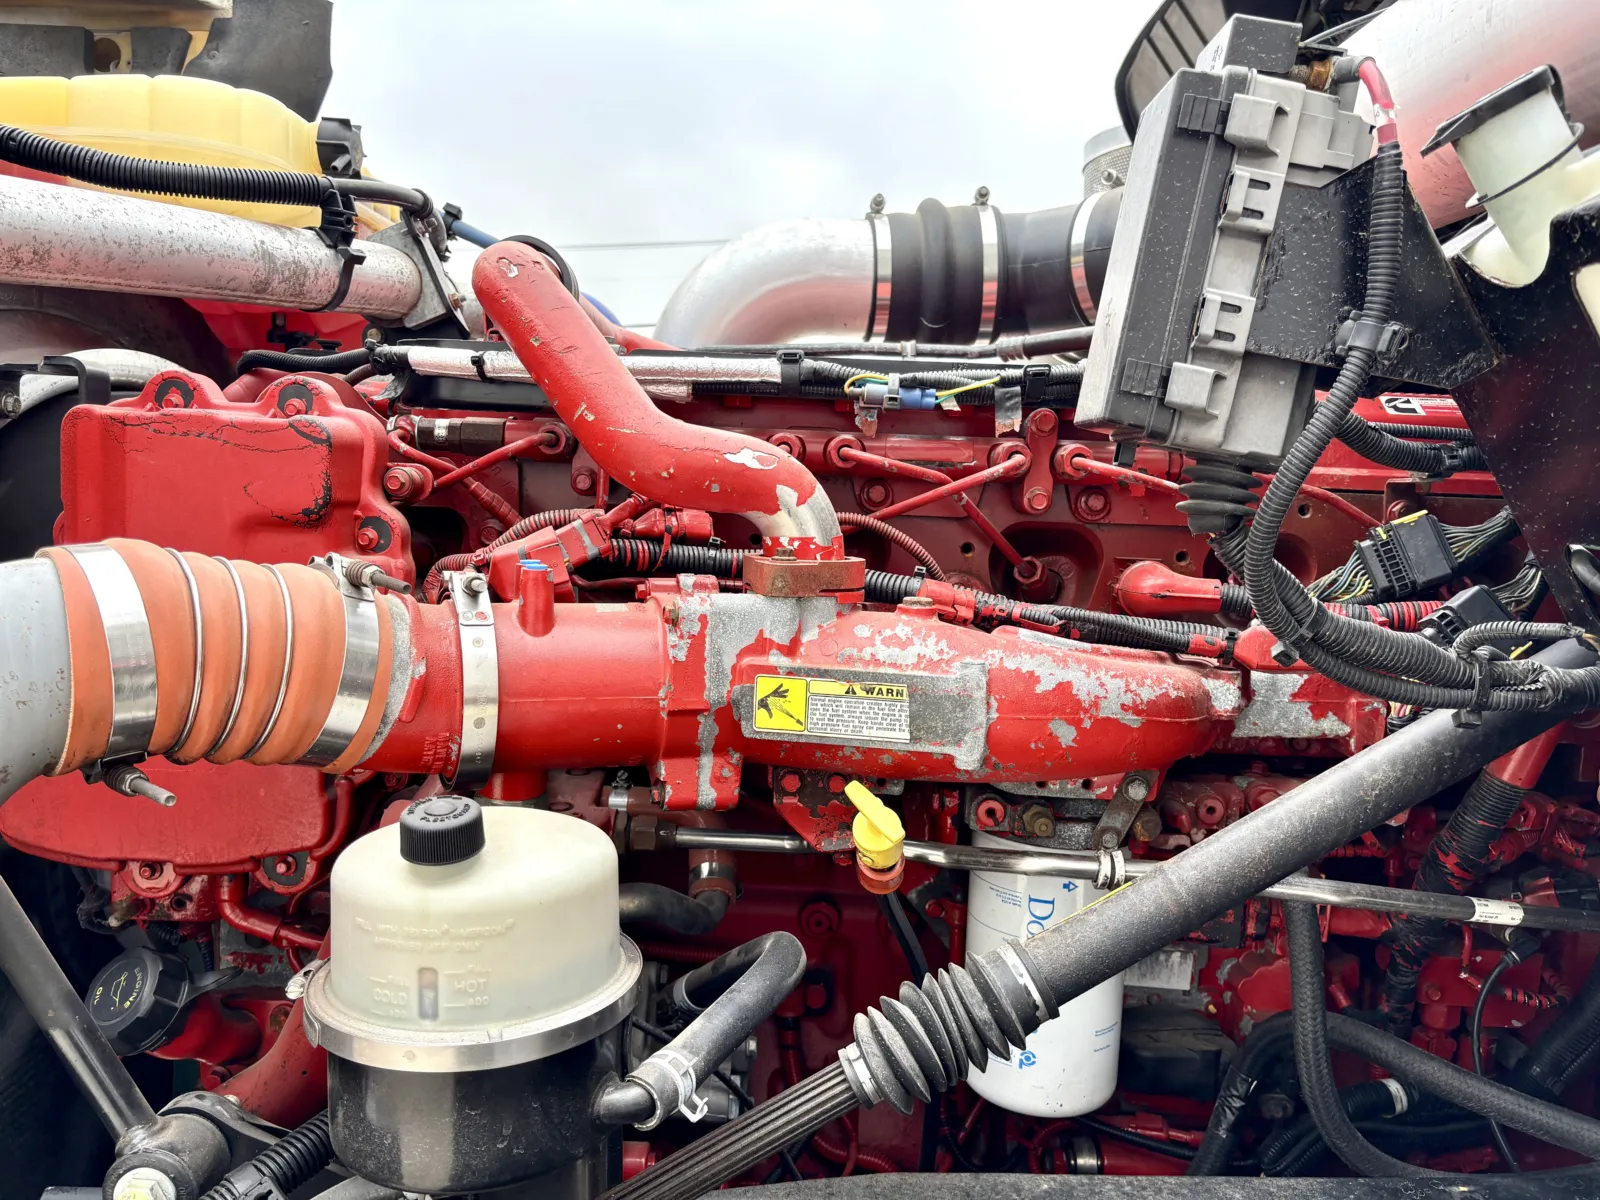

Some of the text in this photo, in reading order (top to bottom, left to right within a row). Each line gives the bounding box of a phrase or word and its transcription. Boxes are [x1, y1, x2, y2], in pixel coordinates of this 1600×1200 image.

[456, 940, 483, 952] ONLY
[468, 964, 492, 972] FULL
[124, 966, 142, 1008] ENGINE
[454, 978, 487, 993] HOT
[94, 986, 103, 1005] OIL
[373, 988, 408, 1006] COLD
[468, 996, 490, 1006] ADD
